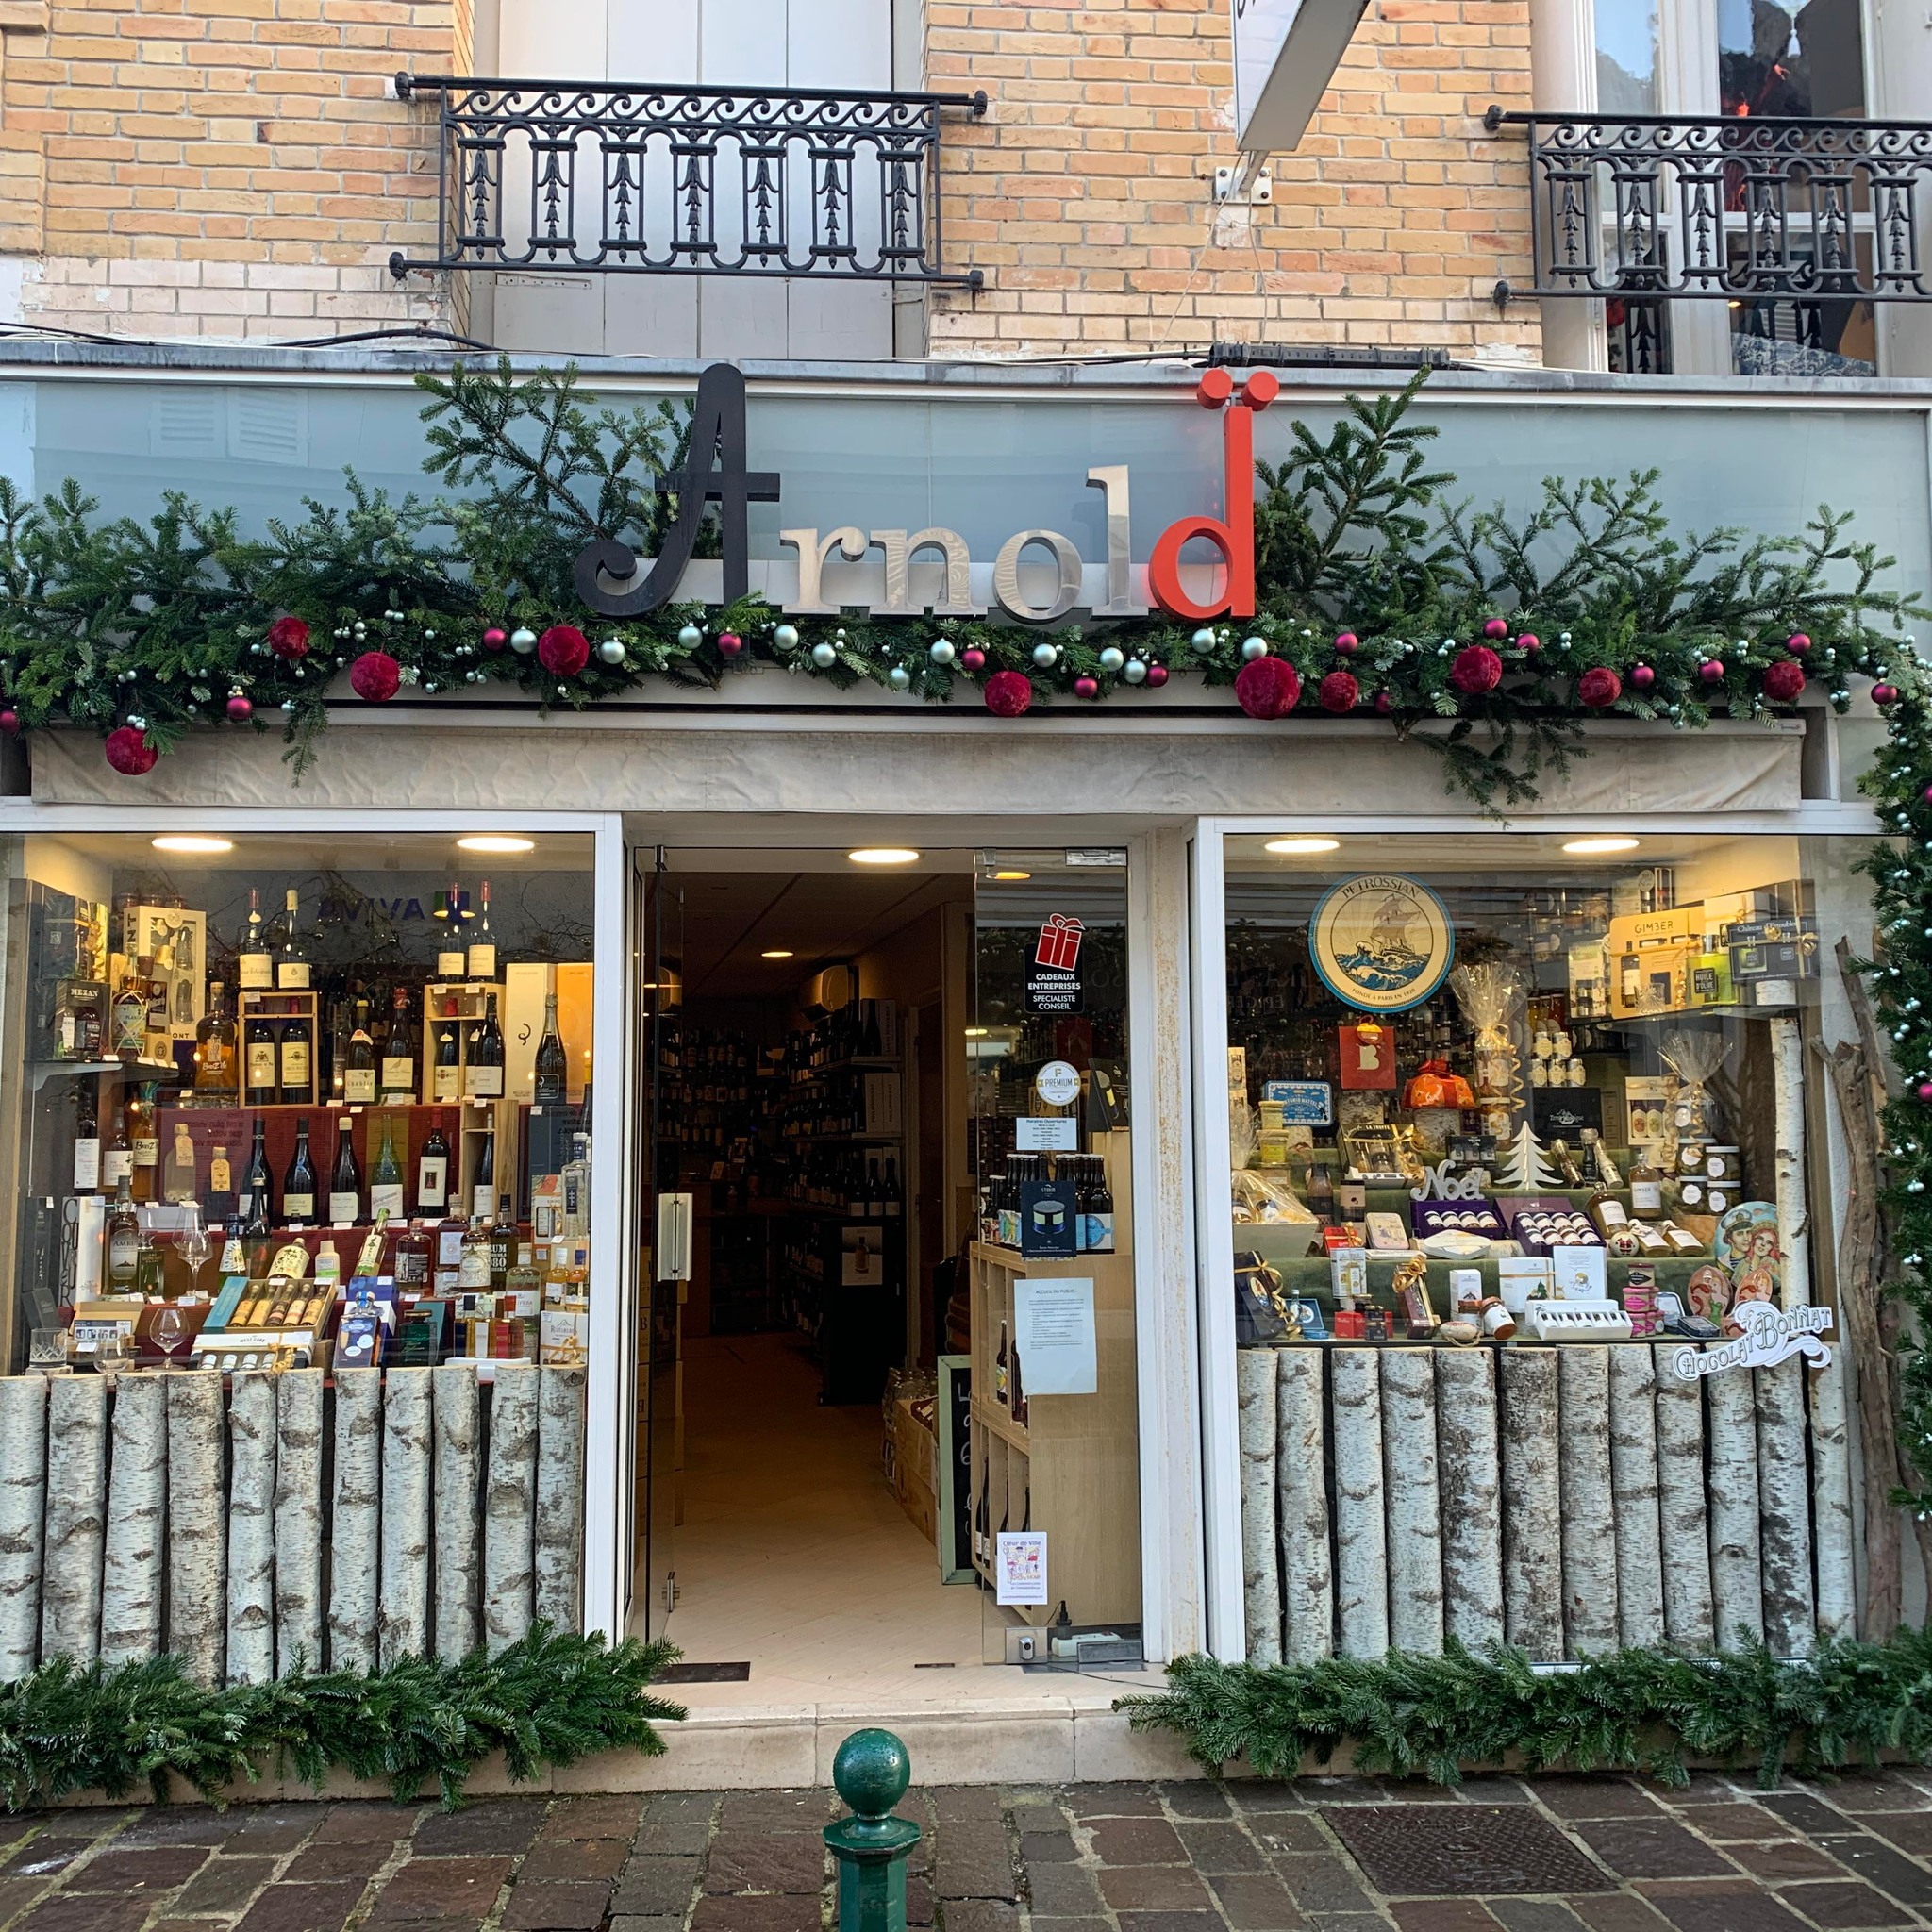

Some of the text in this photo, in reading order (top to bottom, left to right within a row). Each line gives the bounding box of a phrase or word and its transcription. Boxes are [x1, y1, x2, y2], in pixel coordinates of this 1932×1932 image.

[575, 363, 1269, 624] Arnold
[1341, 876, 1421, 899] PETROSSIAN
[1634, 920, 1674, 935] GIMBER
[1035, 973, 1075, 981] CADEAUX
[70, 988, 99, 997] MEZAN
[1357, 1044, 1380, 1070] B
[1044, 1078, 1073, 1087] PREMIUM
[1675, 1305, 1831, 1380] CHOCOLAT BONNAT
